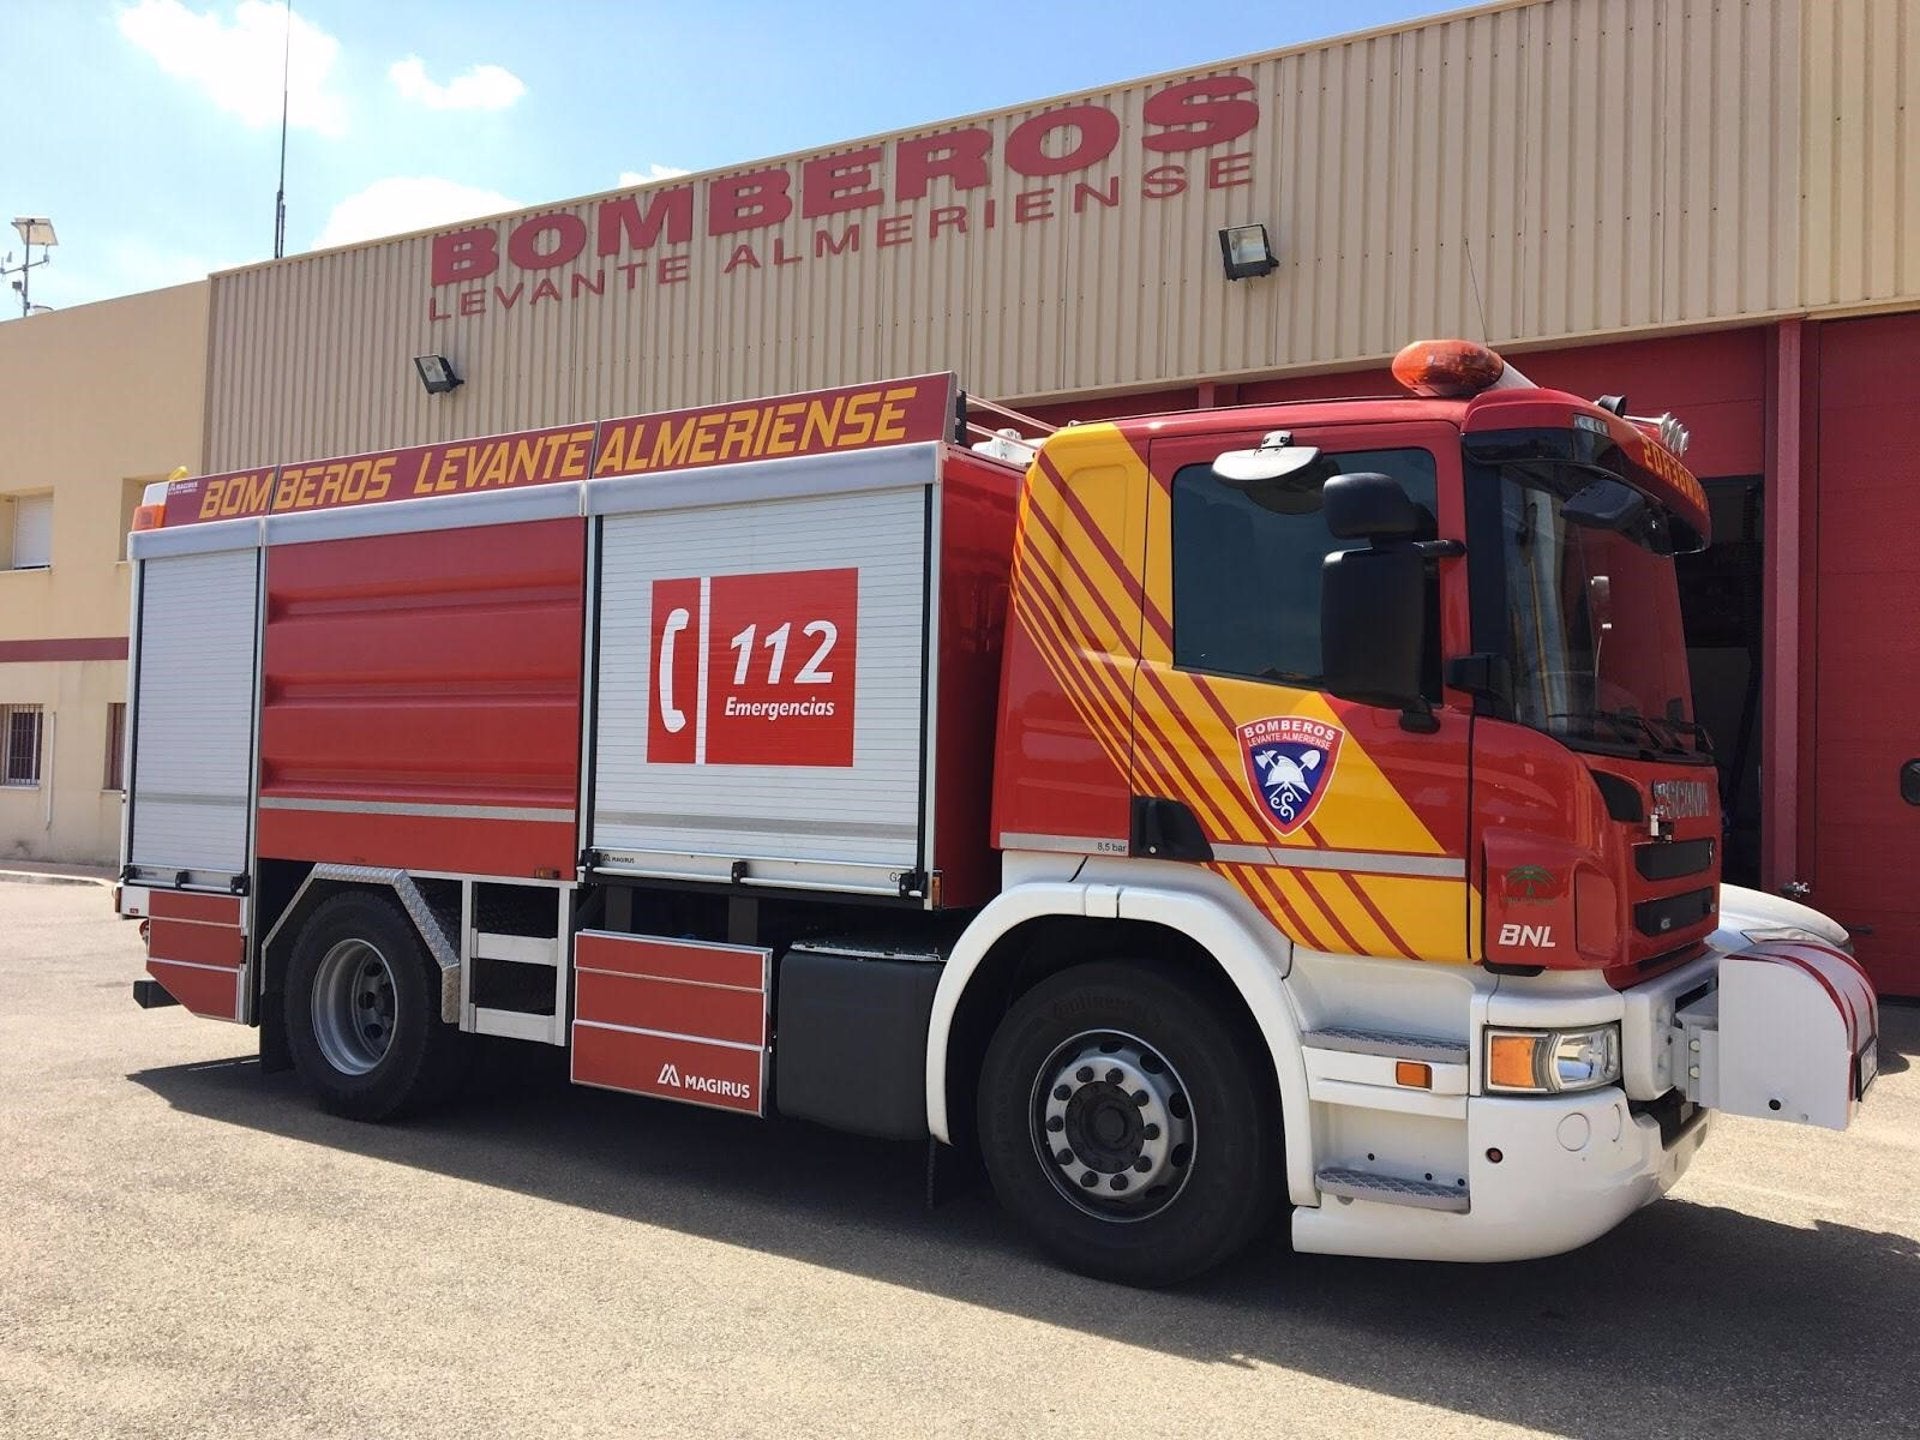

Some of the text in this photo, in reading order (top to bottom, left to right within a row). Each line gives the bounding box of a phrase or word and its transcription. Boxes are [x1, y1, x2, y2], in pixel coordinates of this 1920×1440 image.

[430, 75, 1260, 286] BOMBEROS
[428, 151, 1254, 322] LEVANTE ALMERIENSE
[199, 386, 917, 519] BOMBEROS LEVANTE ALMERIENSE
[730, 619, 839, 685] 112
[724, 696, 835, 721] Emergencias
[1243, 719, 1336, 741] BOMBEROS
[1247, 731, 1333, 751] LEVANTE ALMERIENSE
[1097, 842, 1127, 853] 8,5 bar
[1498, 923, 1556, 948] BNL
[684, 1074, 751, 1099] MAGIRUS
